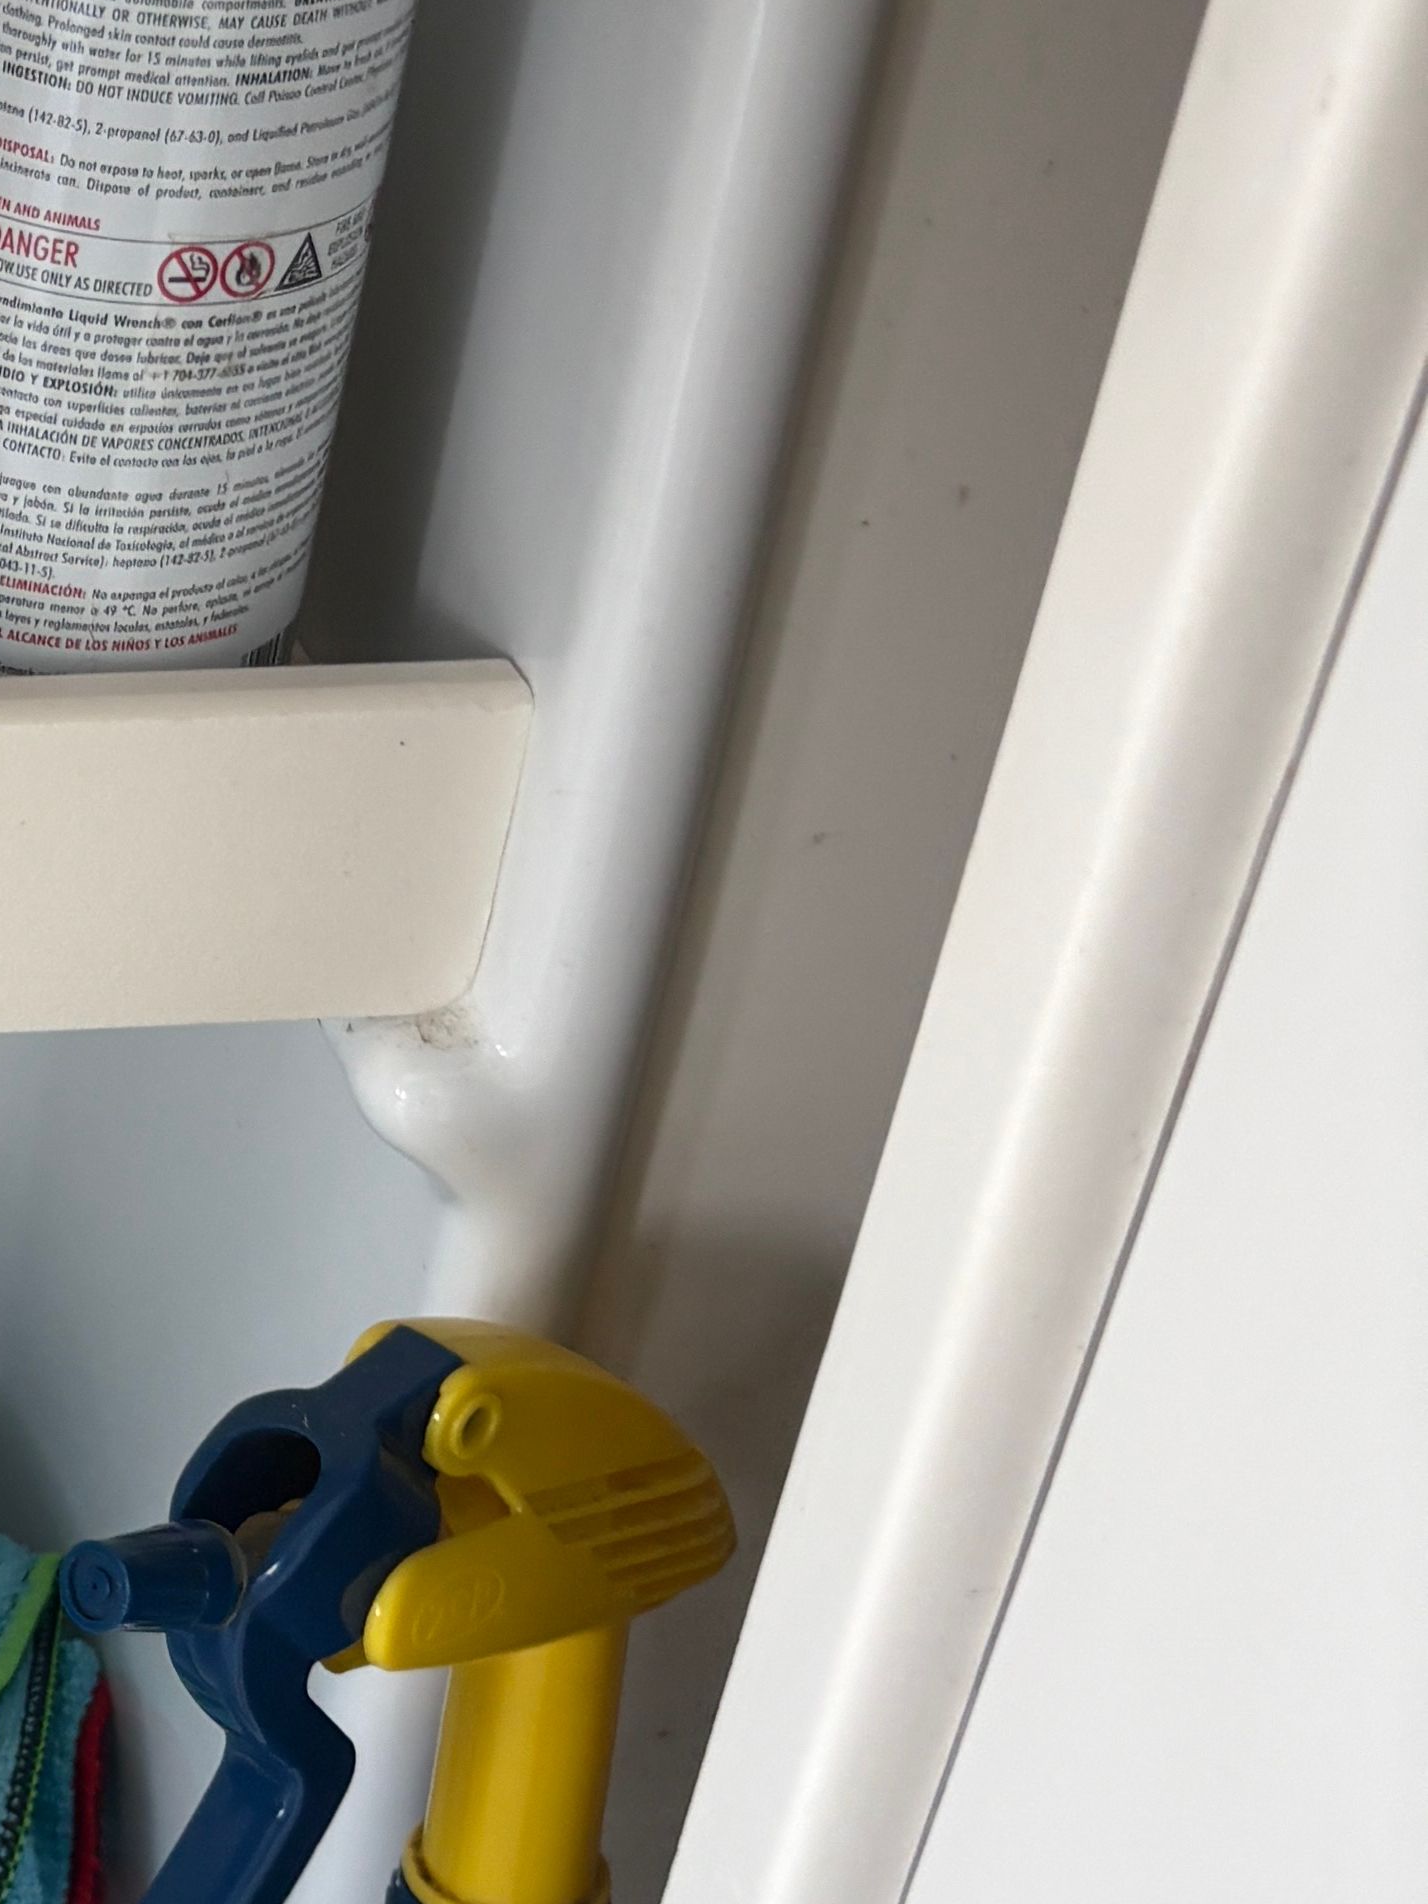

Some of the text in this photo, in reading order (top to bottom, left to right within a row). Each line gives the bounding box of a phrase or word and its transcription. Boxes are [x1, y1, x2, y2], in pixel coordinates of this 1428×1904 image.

[112, 8, 129, 22] OR
[137, 10, 211, 29] OTHERWISE,
[218, 15, 245, 29] MAY
[250, 13, 287, 28] CAUSE
[293, 9, 327, 26] DEATH
[47, 17, 245, 48] Prolonged skin contact could cause
[61, 39, 245, 67] with water for 15 minutes while
[2, 60, 173, 104] INGESTION: DO NOT INDUCE
[56, 58, 313, 86] get prompt medical INHALATION:
[28, 106, 249, 143] (142-82-5), 2-propanol and
[60, 153, 77, 168] Do
[79, 158, 97, 171] not
[157, 168, 185, 180] heat,
[14, 202, 40, 218] AND
[43, 209, 101, 231] ANIMALS
[41, 272, 72, 288] ONLY
[74, 277, 89, 291] AS
[93, 278, 154, 297] DIRECTED
[69, 309, 203, 329] Liquid con
[31, 372, 38, 385] Y
[43, 375, 117, 397] EXPLOSIÓN:
[7, 422, 77, 445] INHALACIÓN
[81, 435, 97, 448] DE
[101, 435, 154, 451] VAPORES
[101, 455, 110, 466] el
[42, 481, 62, 495] con
[68, 486, 129, 502] abundante
[135, 491, 163, 504] agua
[47, 534, 111, 551] Nacional de
[0, 574, 87, 600] ELIMINACIÓN:
[50, 603, 117, 616] menor 49
[7, 629, 61, 648] ALCANCE
[65, 636, 82, 649] DE
[85, 637, 107, 651] LOS
[112, 632, 151, 651] NIÑOS
[155, 639, 162, 650] Y
[164, 636, 184, 649] LOS
[187, 624, 238, 645] ANIMALES
